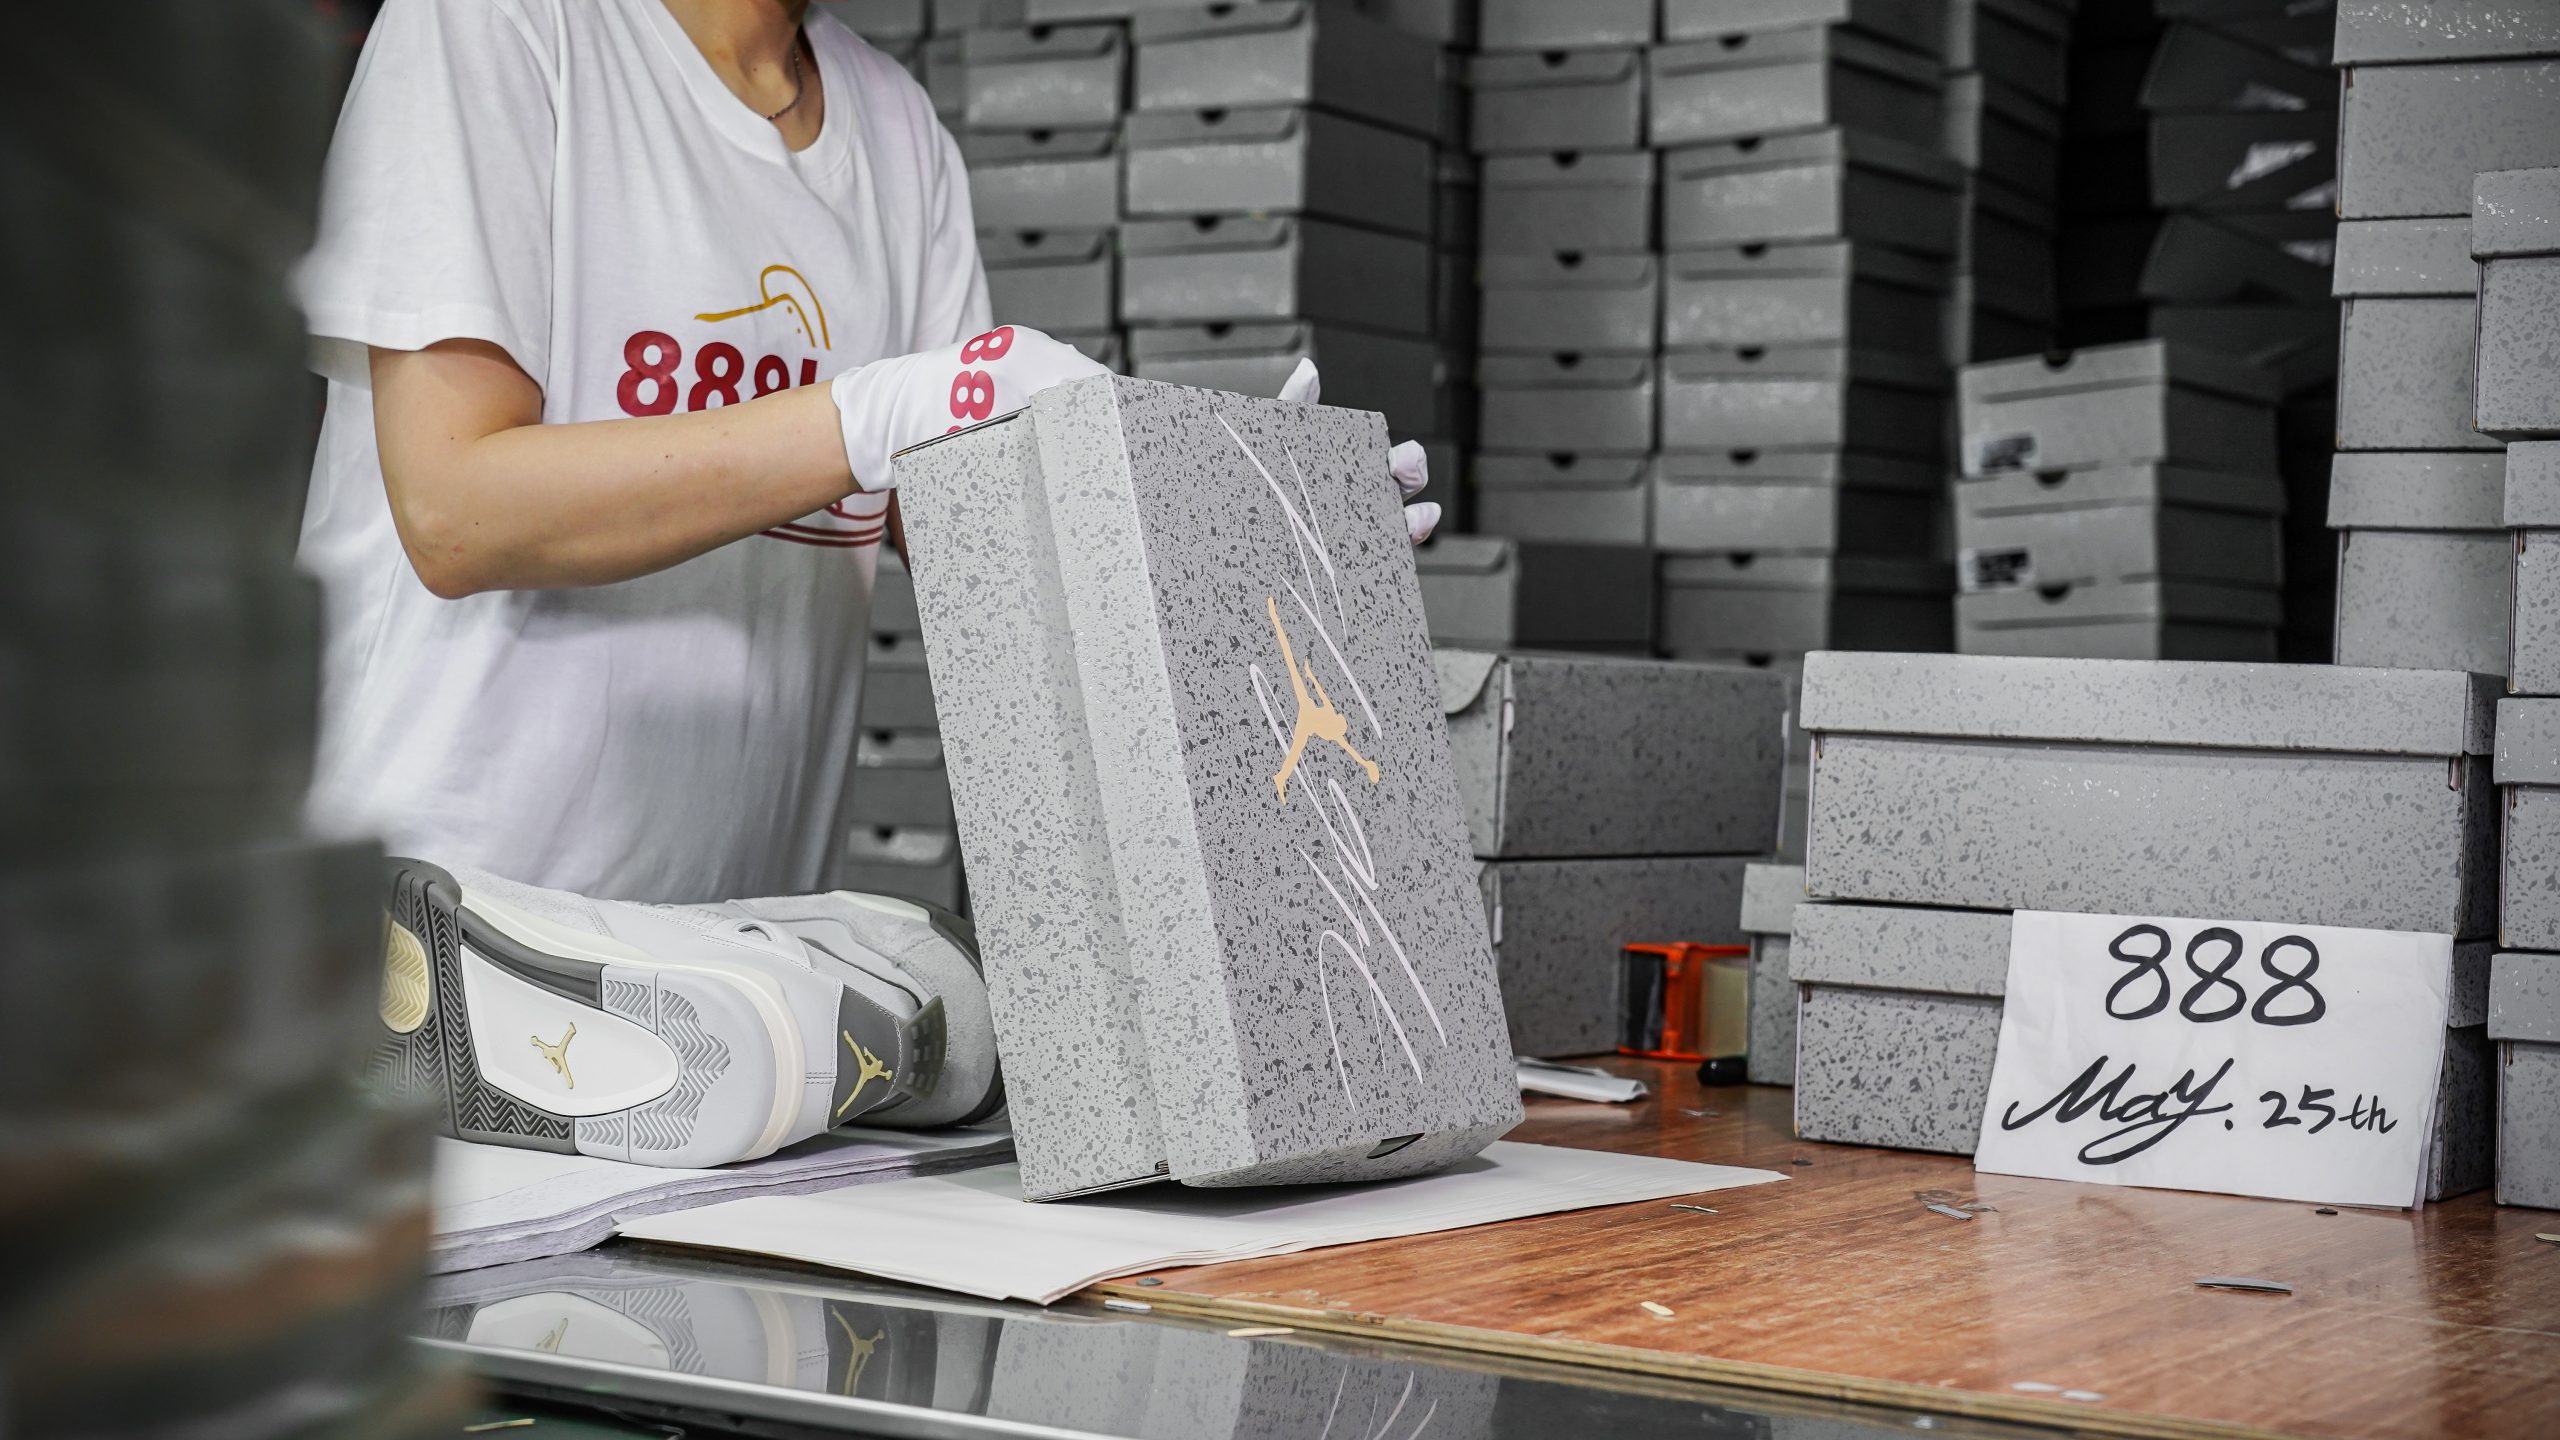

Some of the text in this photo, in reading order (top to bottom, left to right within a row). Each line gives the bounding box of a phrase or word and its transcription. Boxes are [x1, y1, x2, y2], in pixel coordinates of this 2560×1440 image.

[945, 326, 1015, 435] 88
[2105, 923, 2327, 1027] 888
[2259, 1084, 2398, 1135] 25th
